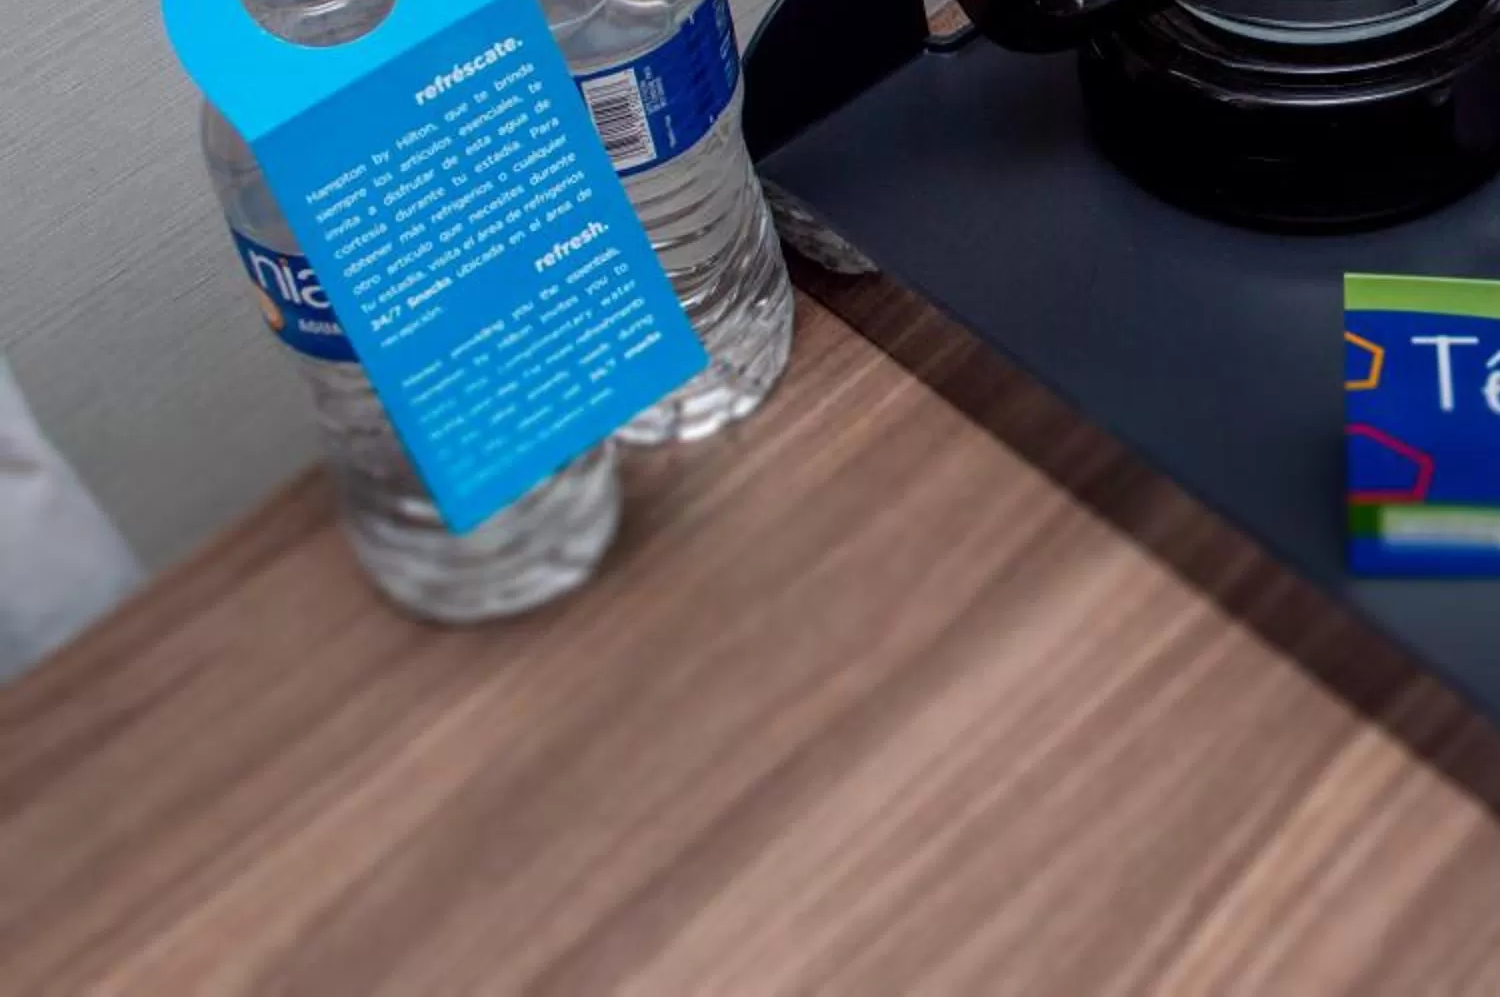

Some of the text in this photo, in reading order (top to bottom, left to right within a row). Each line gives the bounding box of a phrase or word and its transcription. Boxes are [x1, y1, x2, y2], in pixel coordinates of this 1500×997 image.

[415, 37, 523, 105] refréscate.
[529, 117, 560, 139] Para
[371, 150, 390, 166] by
[534, 222, 609, 272] refresh.
